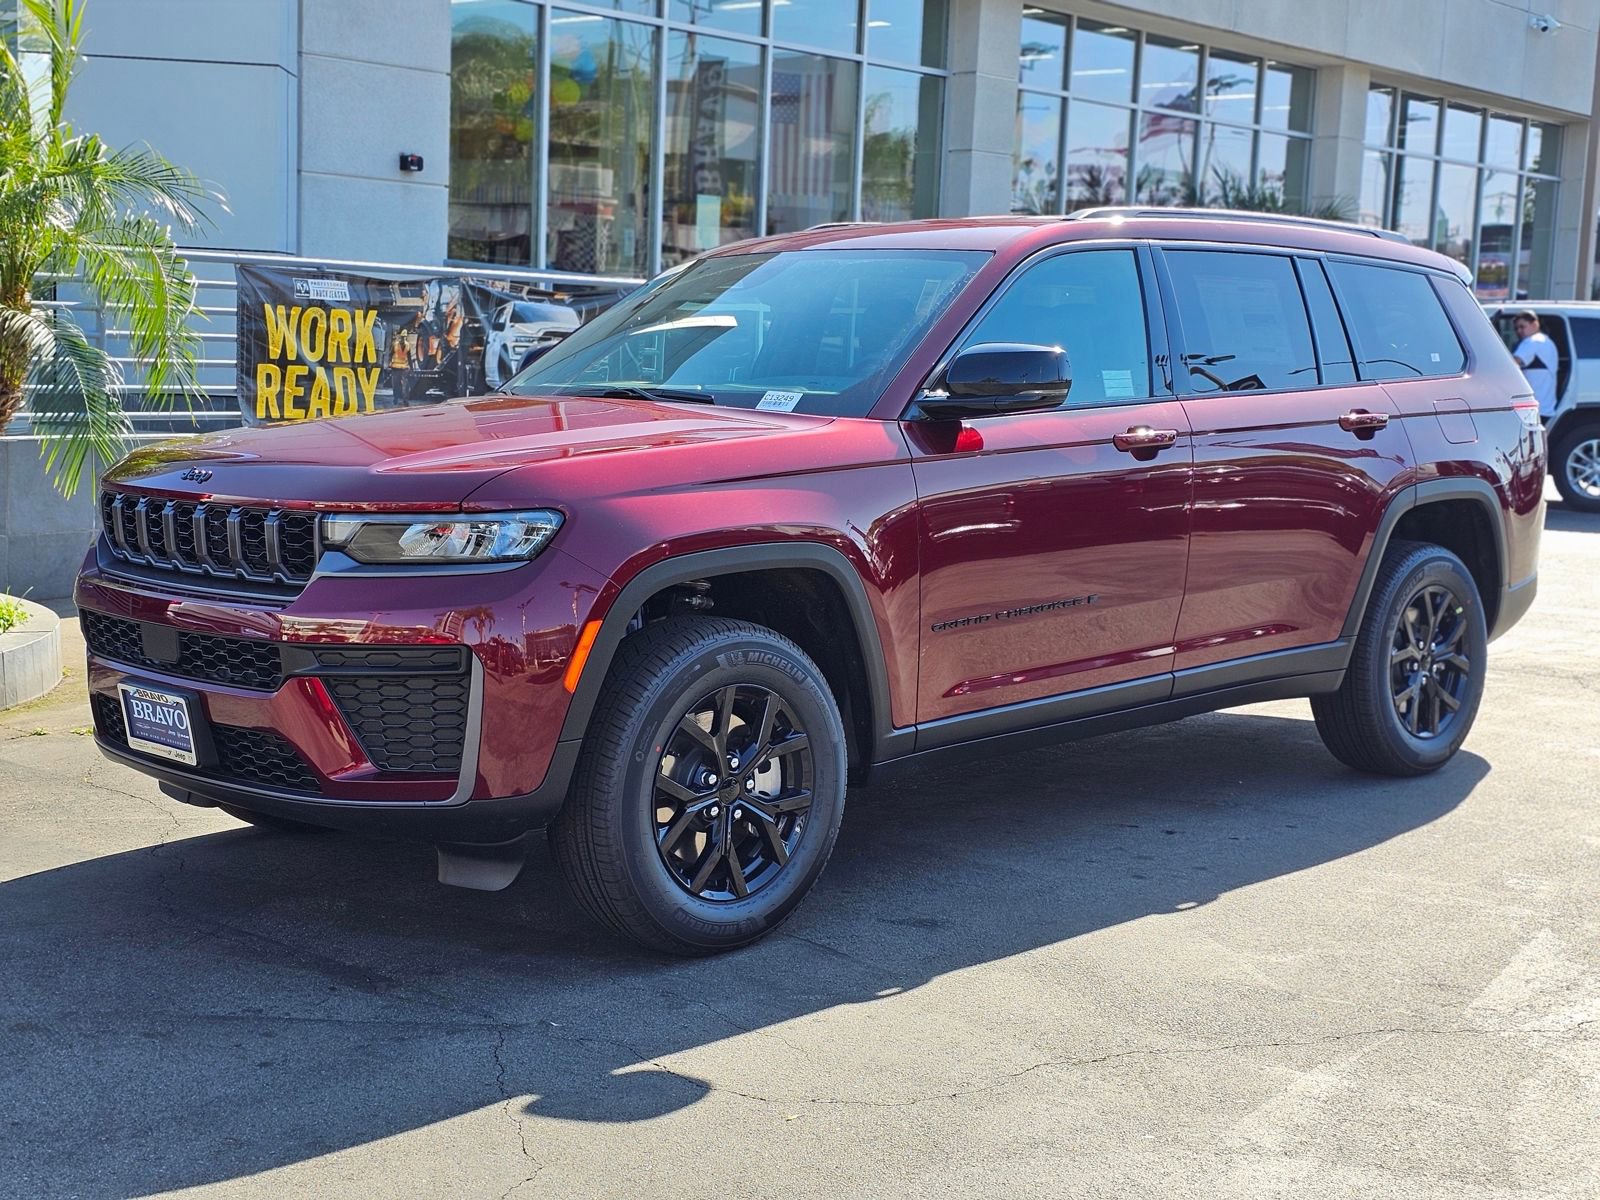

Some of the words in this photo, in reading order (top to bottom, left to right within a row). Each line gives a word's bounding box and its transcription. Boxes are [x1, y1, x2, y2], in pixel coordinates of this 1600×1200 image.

[264, 303, 378, 363] WORK
[256, 363, 382, 419] READY
[180, 466, 213, 485] Jeep
[931, 613, 992, 633] GRAND
[995, 596, 1085, 621] CHEROKEE
[747, 652, 805, 683] MICHELIN
[137, 690, 169, 704] BRAVO
[130, 699, 187, 730] BRAVO
